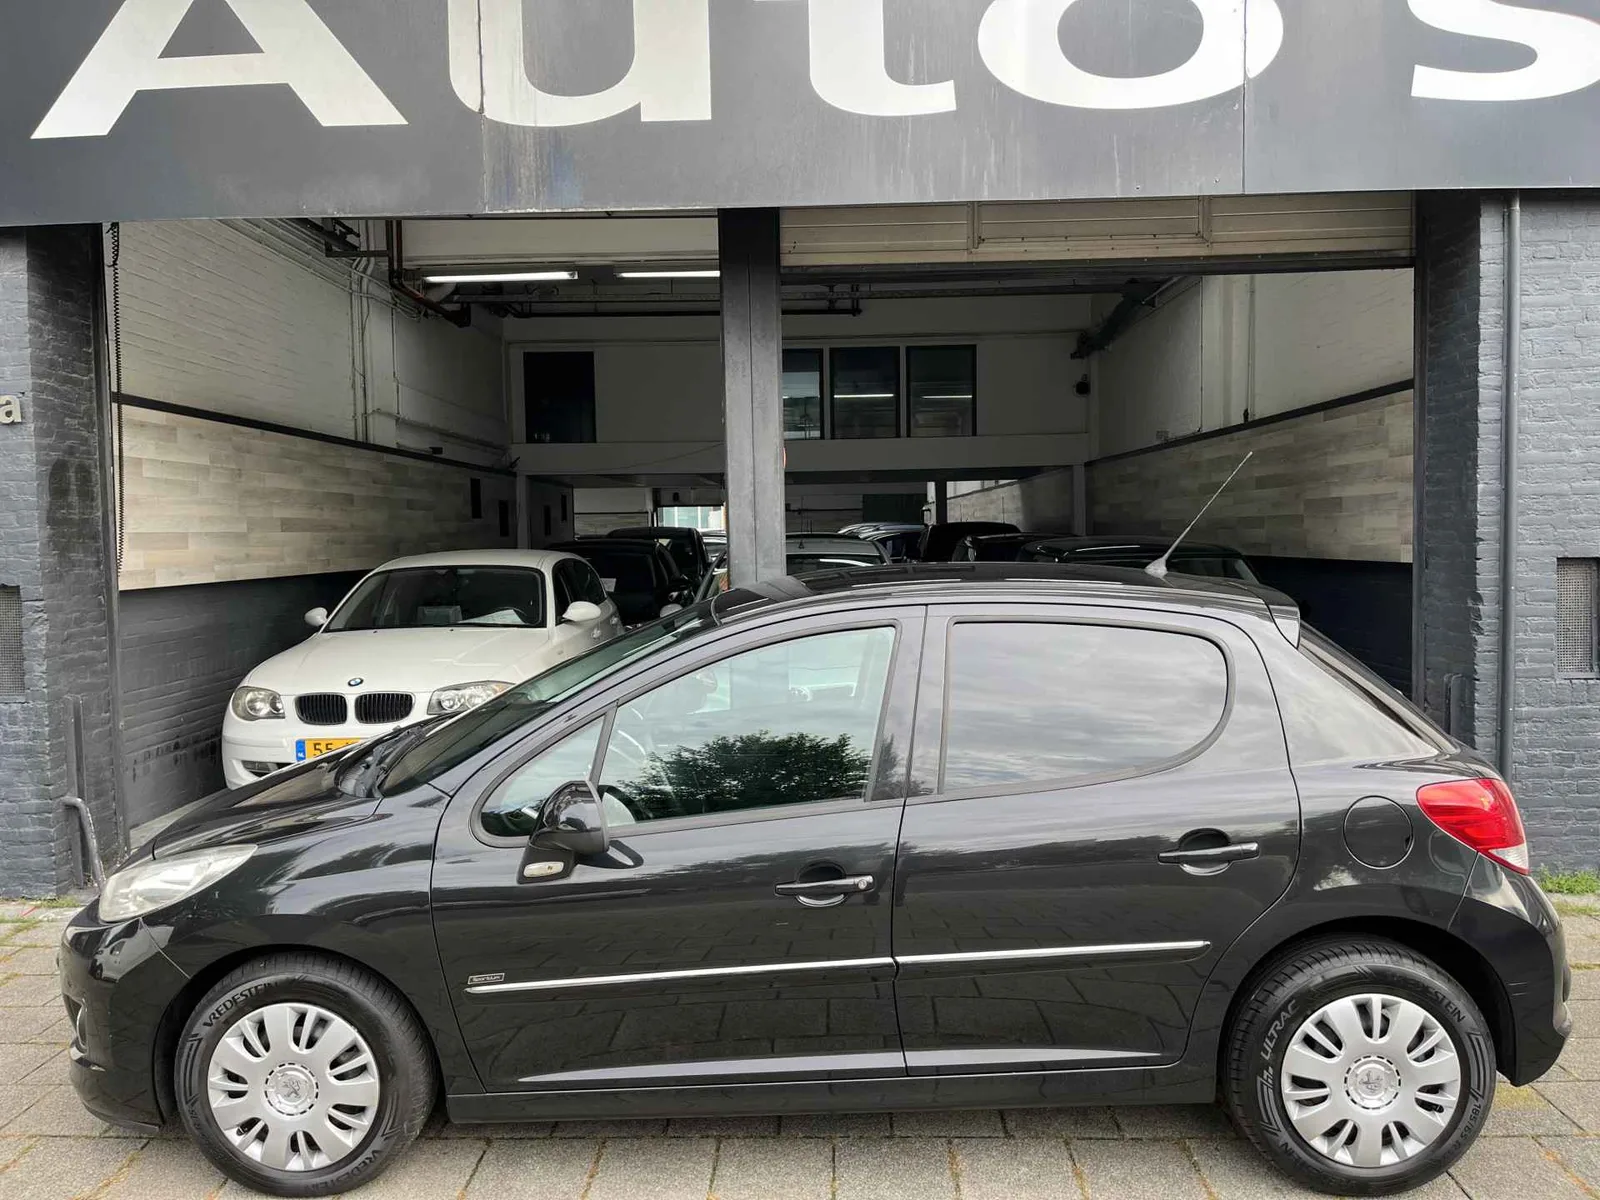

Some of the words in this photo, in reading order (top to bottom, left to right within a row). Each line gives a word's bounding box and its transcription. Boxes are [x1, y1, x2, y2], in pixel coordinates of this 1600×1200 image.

[31, 0, 1600, 139] Autos
[203, 981, 280, 1027] VREDESTEIN
[1261, 1000, 1297, 1060] ULTRAC
